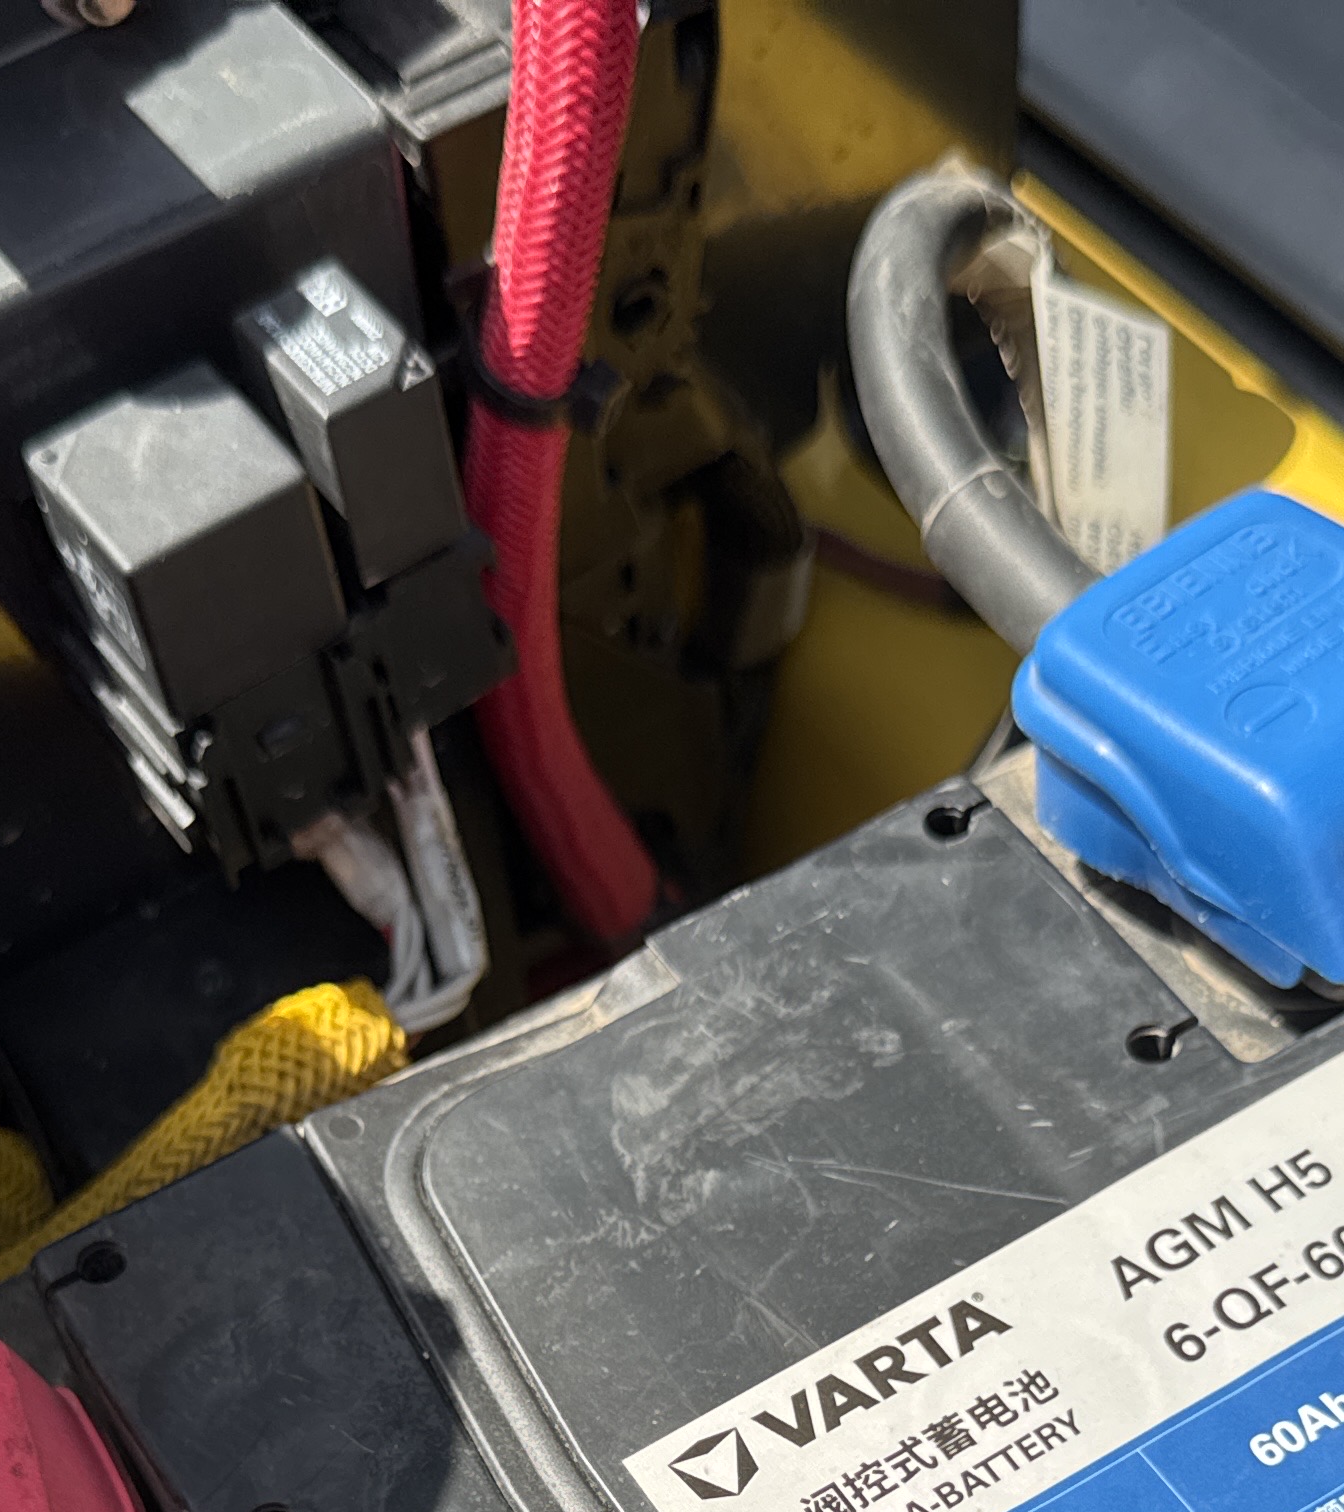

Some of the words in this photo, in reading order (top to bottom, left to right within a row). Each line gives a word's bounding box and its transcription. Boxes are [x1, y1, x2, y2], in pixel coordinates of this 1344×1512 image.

[1108, 1194, 1253, 1300] AGM
[1247, 1148, 1333, 1214] H5
[750, 1298, 1013, 1449] VARTA
